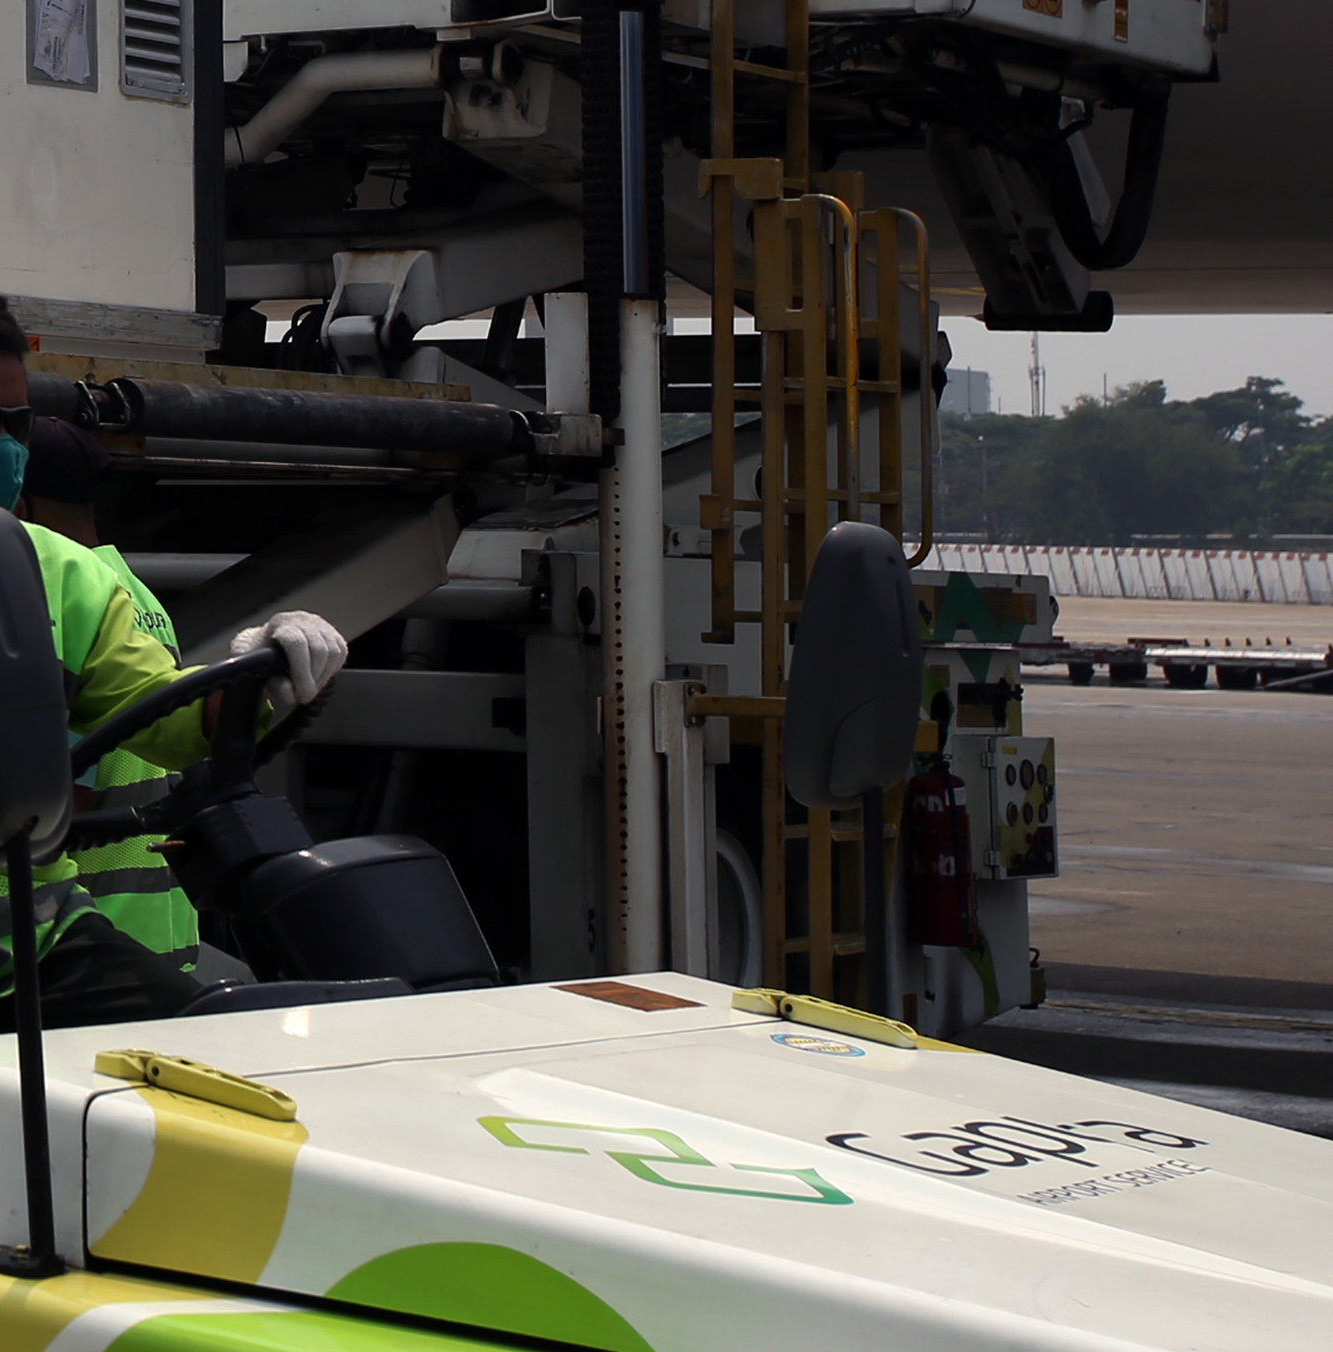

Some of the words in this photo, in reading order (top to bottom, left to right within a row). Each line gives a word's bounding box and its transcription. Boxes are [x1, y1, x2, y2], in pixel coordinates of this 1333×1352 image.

[824, 1115, 1211, 1177] Gapa
[1017, 1178, 1124, 1207] AIRPORT
[1102, 1158, 1213, 1189] SERVICE
